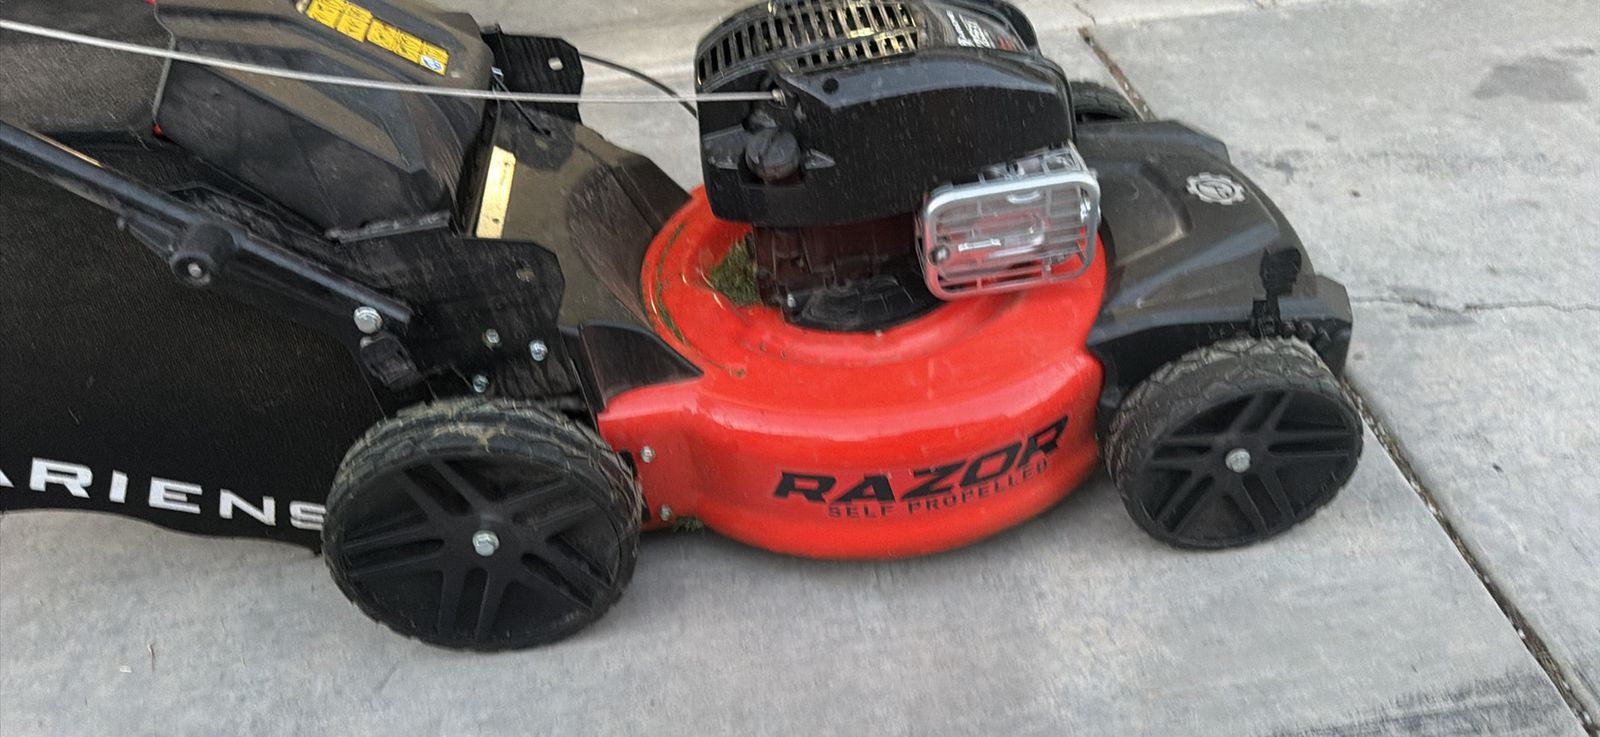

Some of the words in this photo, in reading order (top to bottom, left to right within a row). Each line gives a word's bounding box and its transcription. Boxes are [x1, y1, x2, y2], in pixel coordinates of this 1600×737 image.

[0, 457, 326, 531] RIENS
[774, 415, 1069, 504] RAZOR
[828, 504, 896, 519] SELF
[907, 460, 1049, 514] PROPELLED
